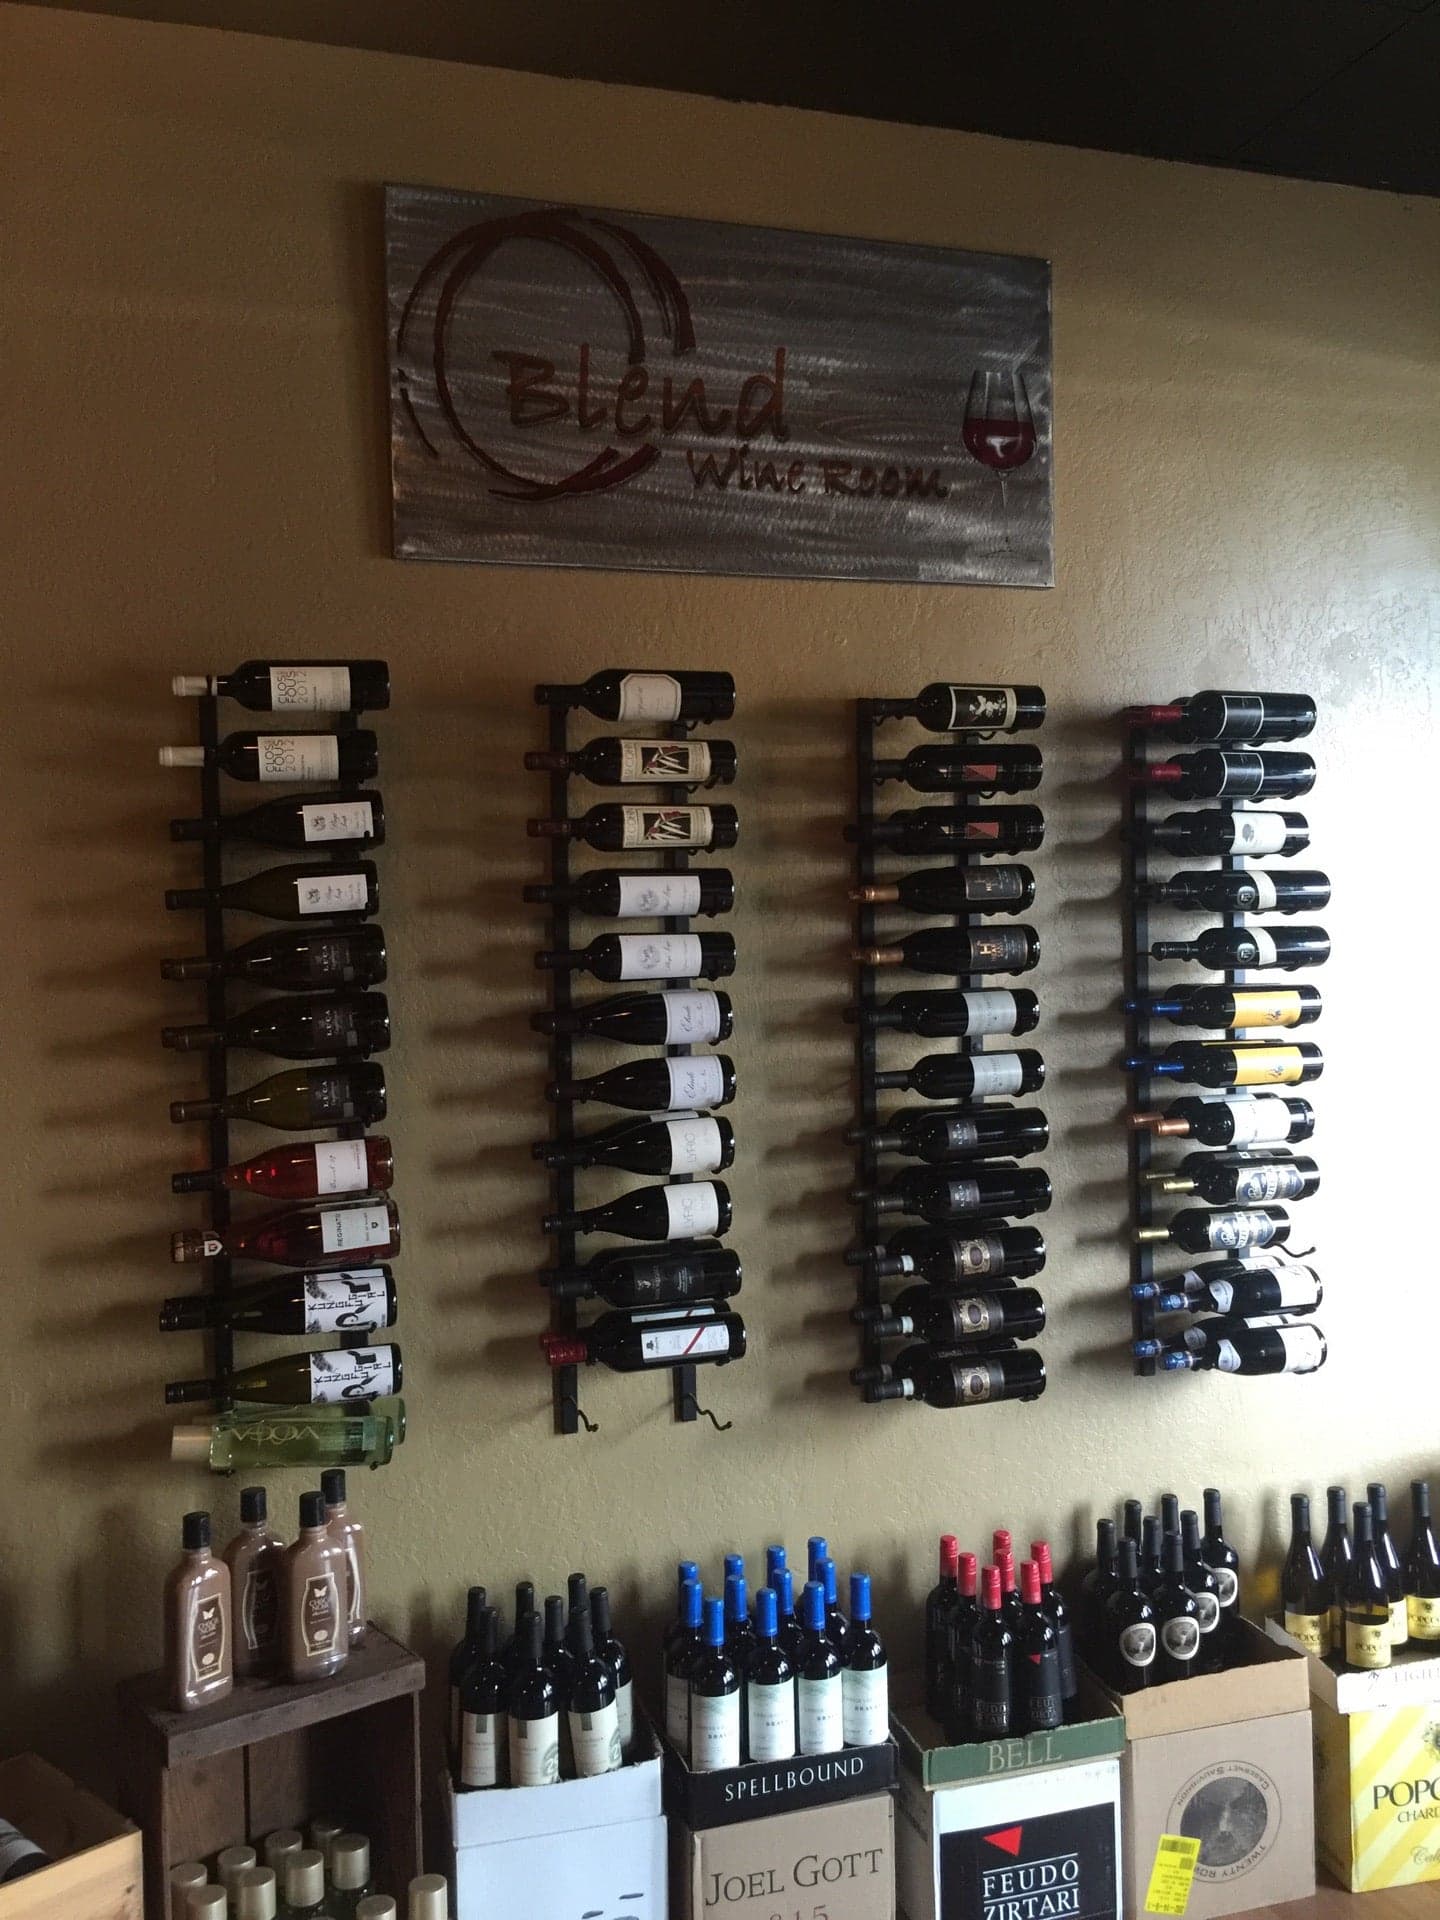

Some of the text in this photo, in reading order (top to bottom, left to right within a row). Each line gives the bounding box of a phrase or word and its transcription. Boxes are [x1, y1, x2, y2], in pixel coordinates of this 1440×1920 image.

[493, 343, 791, 443] Blend
[687, 443, 807, 495] Wine
[307, 1301, 345, 1311] KUNG
[347, 1291, 385, 1301] GIRL
[313, 1373, 350, 1384] KUNG
[354, 1361, 391, 1372] GIRL
[988, 1736, 1063, 1772] BELL
[725, 1756, 863, 1802] SPELLBOUND
[705, 1848, 883, 1906] JOEL GOTT
[1220, 1843, 1267, 1878] TWENTY
[983, 1859, 1079, 1898] FEUDO
[983, 1888, 1080, 1920] ZIRTARI
